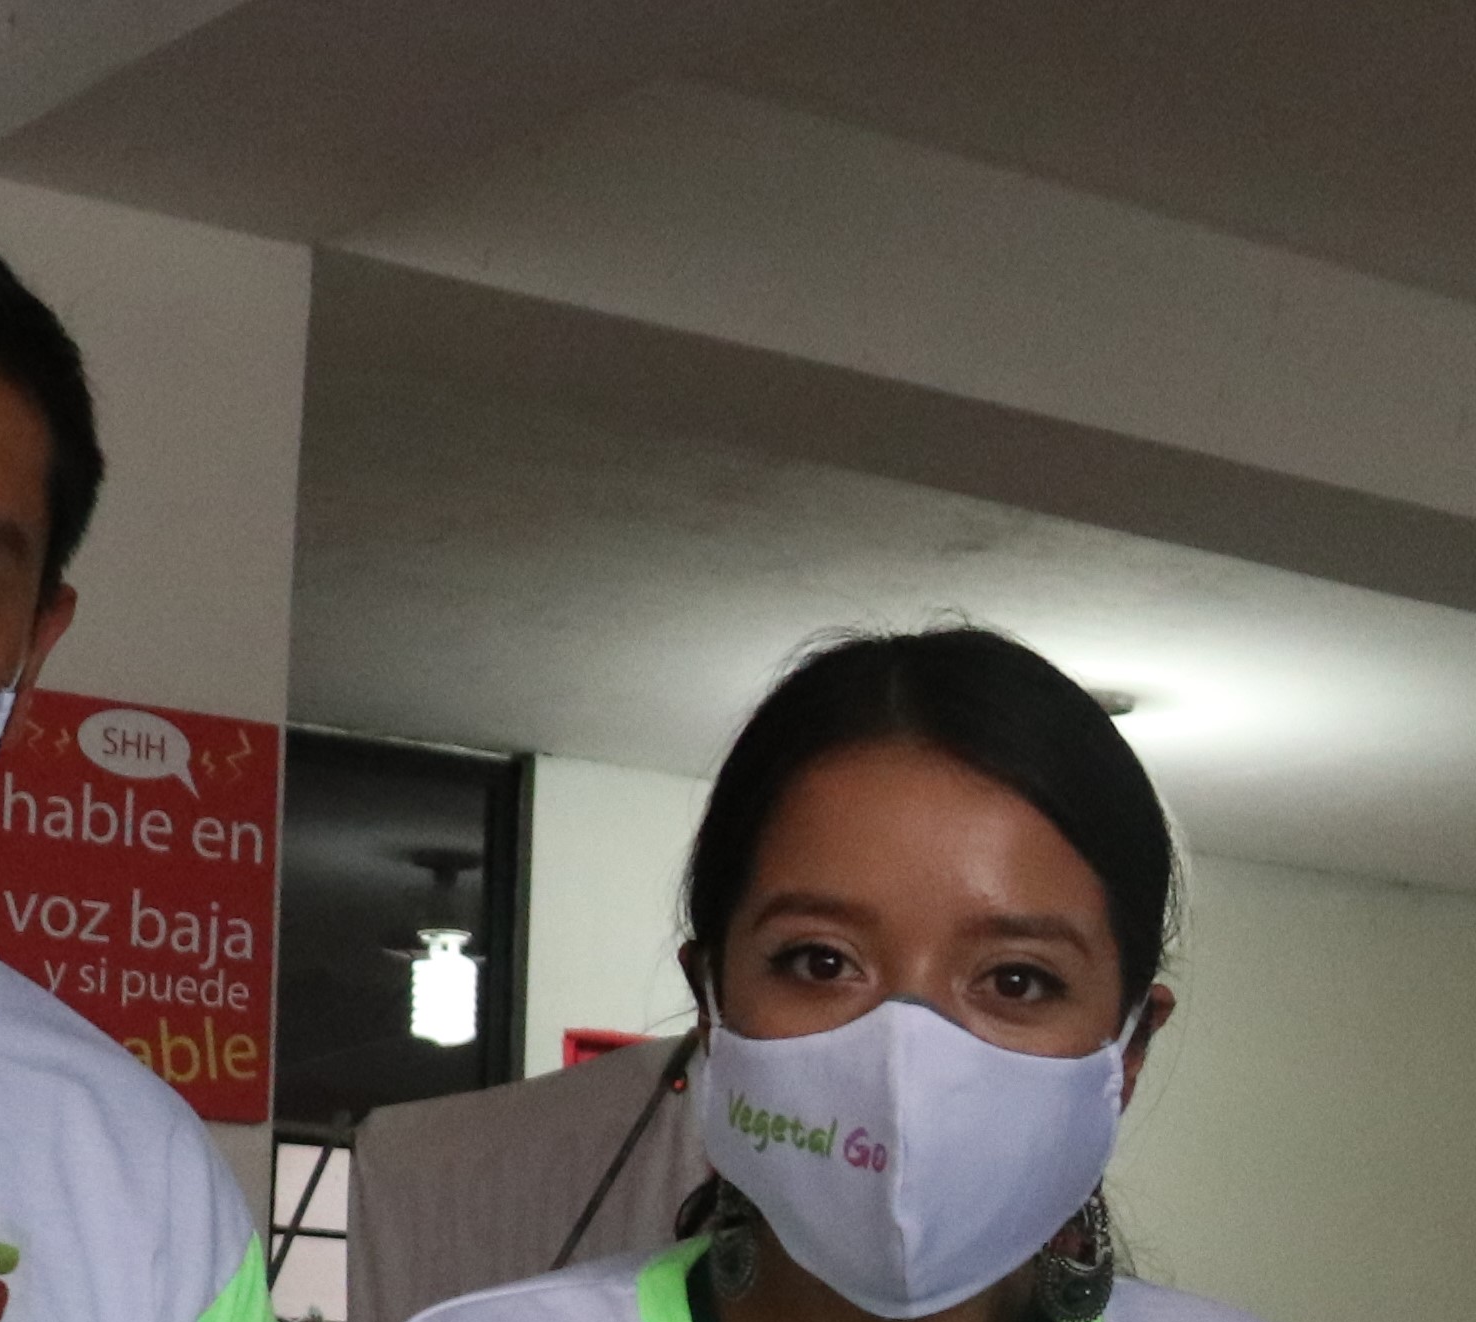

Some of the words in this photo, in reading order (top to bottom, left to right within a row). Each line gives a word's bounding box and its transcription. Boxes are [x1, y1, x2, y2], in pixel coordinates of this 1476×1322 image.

[102, 726, 166, 763] SHH
[2, 771, 173, 853] hable
[192, 814, 264, 865] en
[4, 889, 110, 944] voz
[130, 887, 253, 970] baja
[44, 959, 67, 994] y
[78, 957, 108, 994] si
[122, 967, 250, 1008] puede
[123, 1015, 259, 1083] able
[728, 1088, 839, 1159] Vegetal
[843, 1126, 888, 1173] Go
